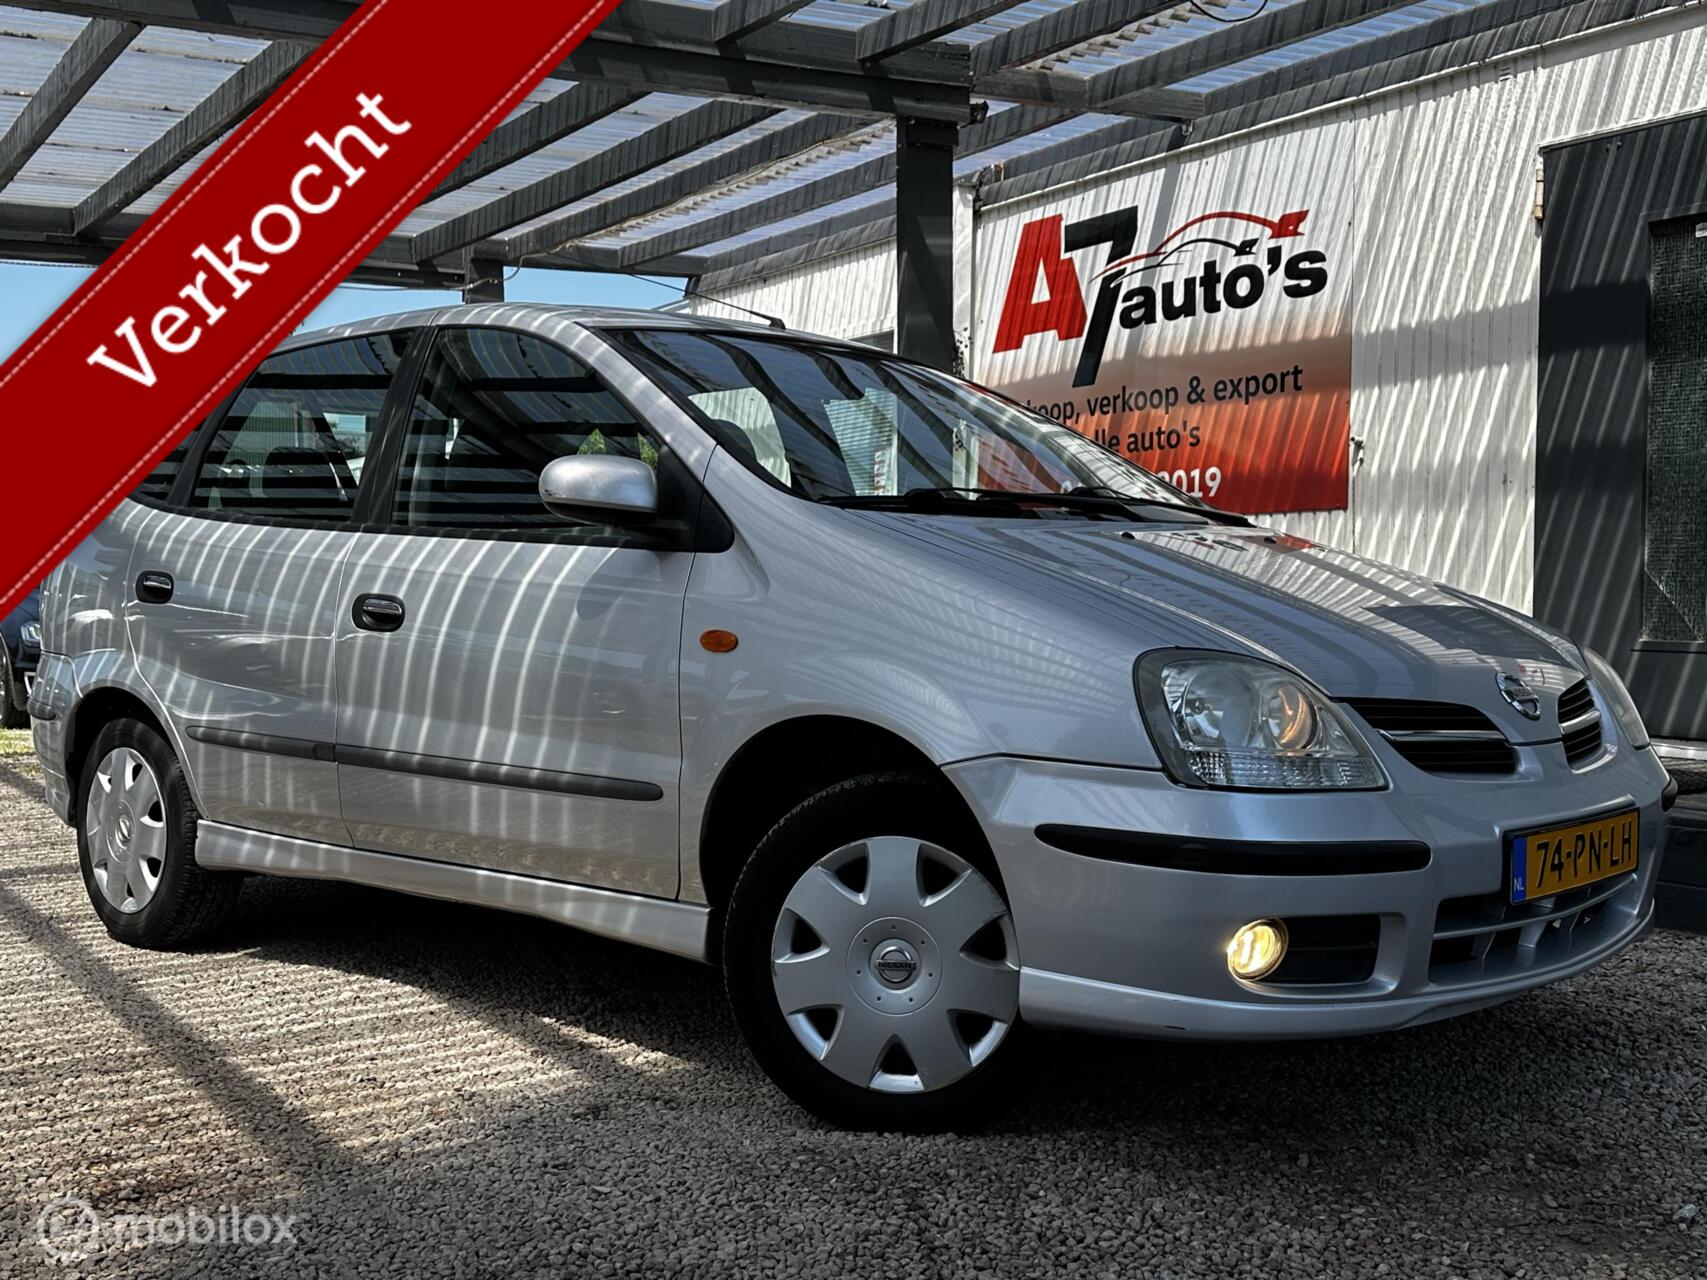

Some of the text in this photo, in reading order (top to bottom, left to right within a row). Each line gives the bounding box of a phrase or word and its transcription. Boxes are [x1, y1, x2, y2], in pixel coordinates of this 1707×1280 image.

[1119, 245, 1328, 330] auto's
[1087, 384, 1179, 417] verkoop
[1188, 376, 1205, 404] &
[1214, 365, 1303, 406] export
[1126, 420, 1200, 453] auto's
[1536, 820, 1632, 888] 74-PN-LH
[1513, 877, 1524, 891] NL
